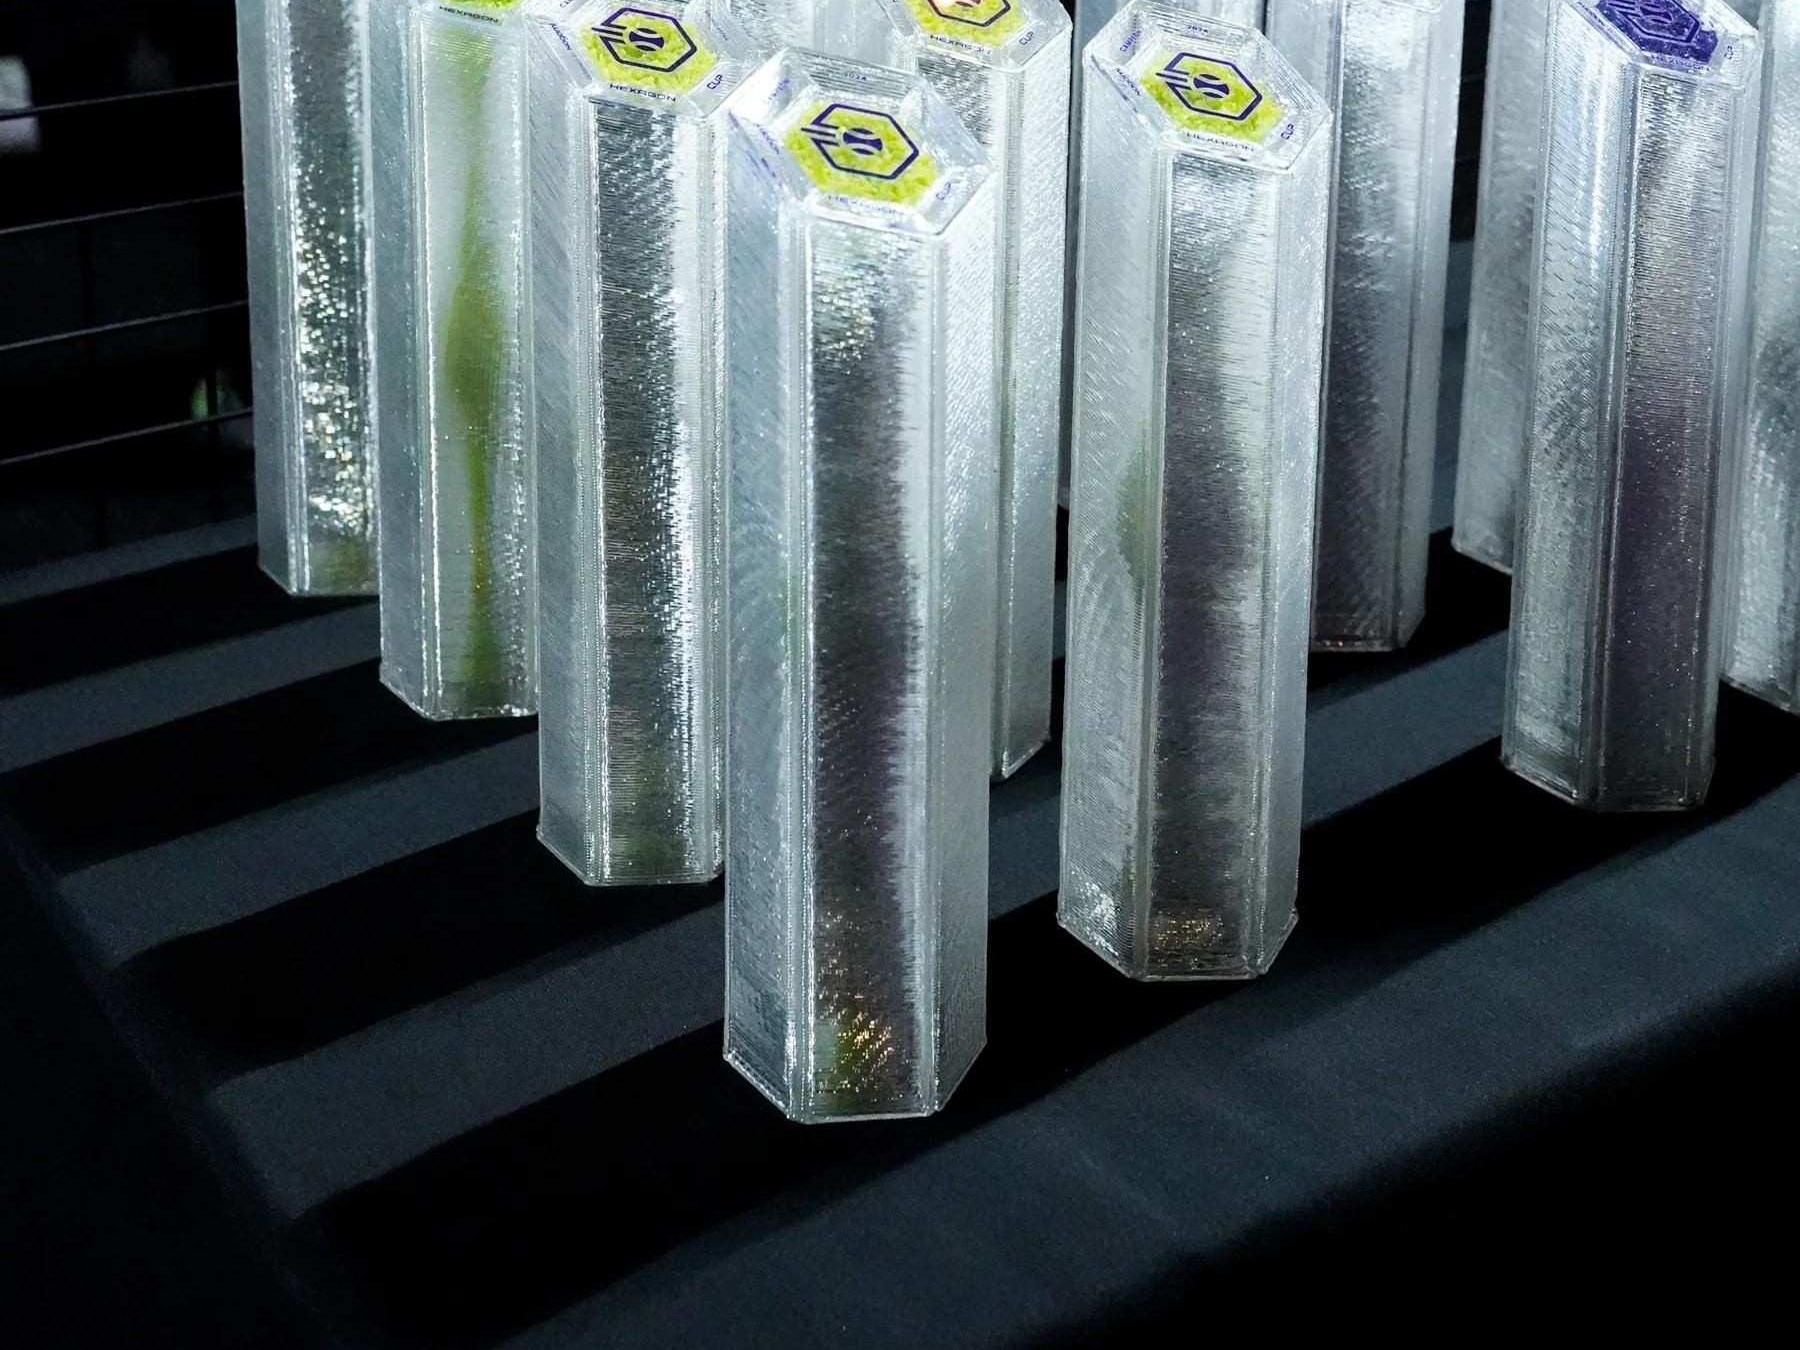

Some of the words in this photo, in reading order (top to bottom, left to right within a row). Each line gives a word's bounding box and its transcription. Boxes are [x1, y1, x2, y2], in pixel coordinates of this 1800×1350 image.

[438, 4, 500, 24] HEXAGON
[1186, 23, 1210, 34] 2024
[929, 34, 992, 55] HEXAGON
[1018, 31, 1035, 47] CUP
[706, 73, 724, 90] CUP
[609, 83, 677, 102] HEXAGON
[1280, 123, 1295, 141] CUP
[1186, 131, 1255, 152] HEXAGON
